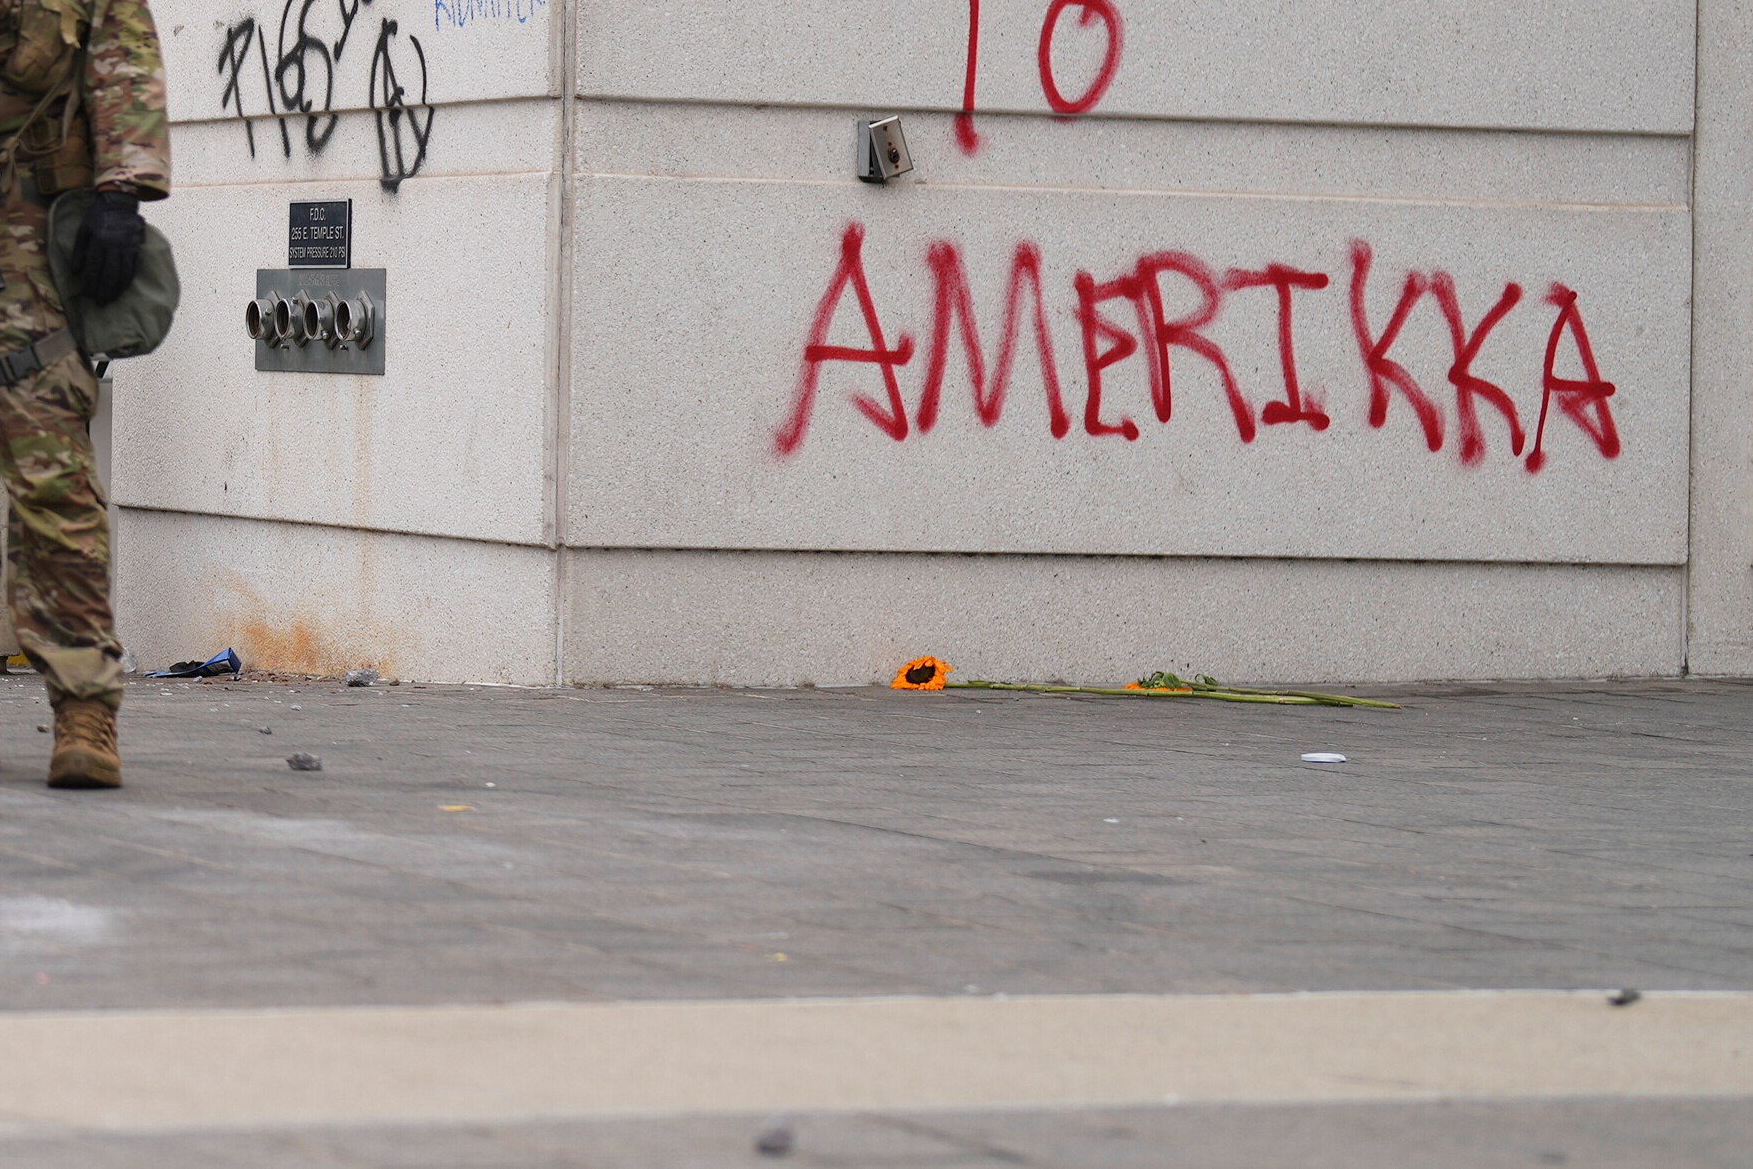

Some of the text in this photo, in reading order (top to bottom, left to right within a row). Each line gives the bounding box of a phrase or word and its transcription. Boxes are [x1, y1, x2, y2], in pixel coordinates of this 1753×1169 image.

[309, 207, 326, 221] F.D.C.
[310, 226, 334, 240] TEMPLE
[335, 225, 344, 239] ST.
[289, 246, 306, 259] SYSTEM
[307, 246, 328, 259] PRESSURE
[774, 221, 1622, 474] AMERIKKA
